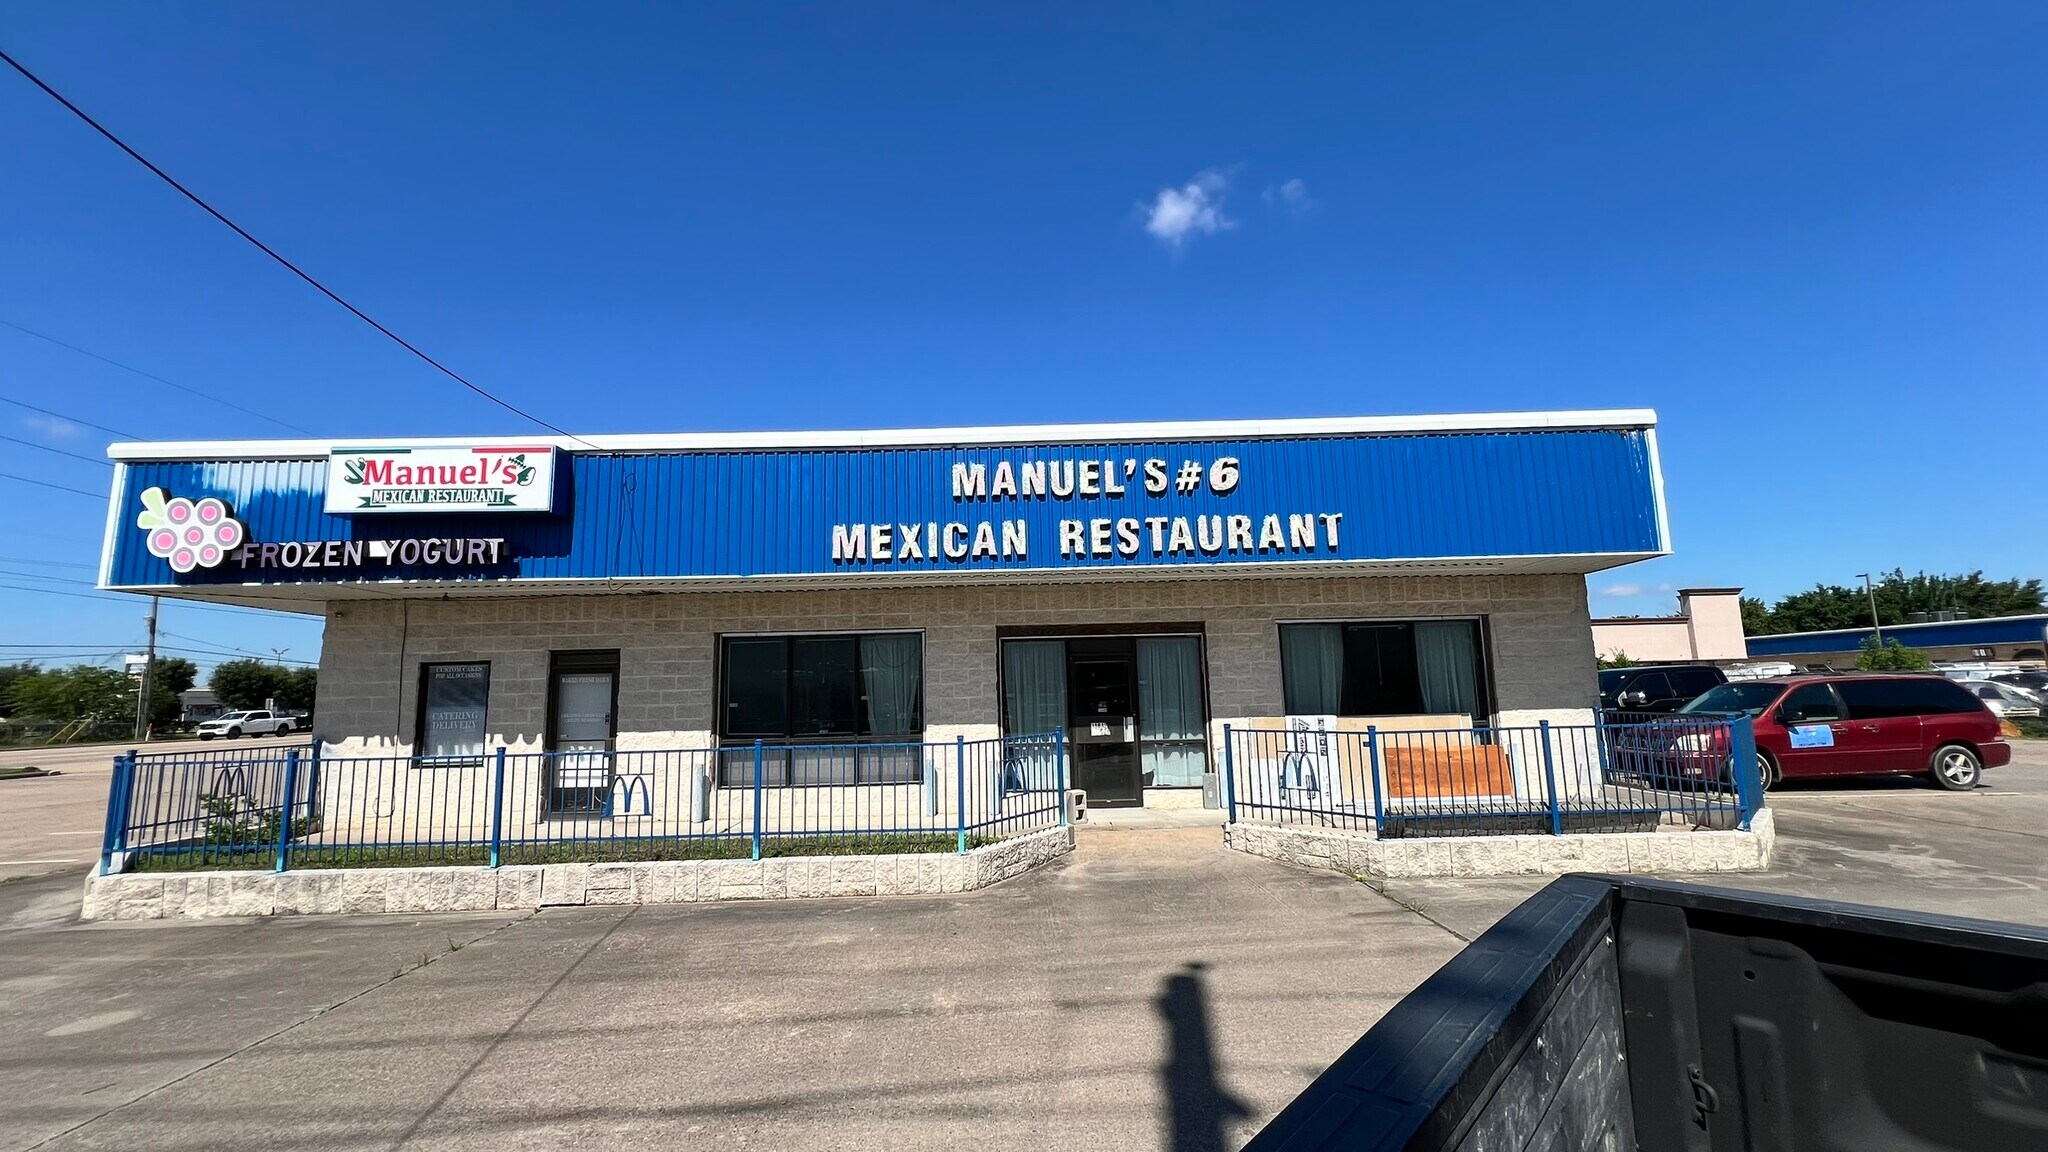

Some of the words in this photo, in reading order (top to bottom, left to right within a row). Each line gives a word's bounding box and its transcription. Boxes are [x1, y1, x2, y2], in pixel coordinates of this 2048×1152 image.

[362, 456, 517, 486] Manuel's
[952, 458, 1168, 499] MANUEL'S
[1175, 456, 1241, 492] #6
[372, 489, 424, 504] MEXICAN
[429, 488, 504, 504] RESTAURANT
[832, 519, 1026, 560] MEXICAN
[1060, 512, 1343, 556] RESTAURANT
[241, 541, 363, 569] FROZEN
[381, 537, 504, 566] YOGURT
[432, 711, 478, 720] CATERING
[432, 720, 478, 730] DELIVERY
